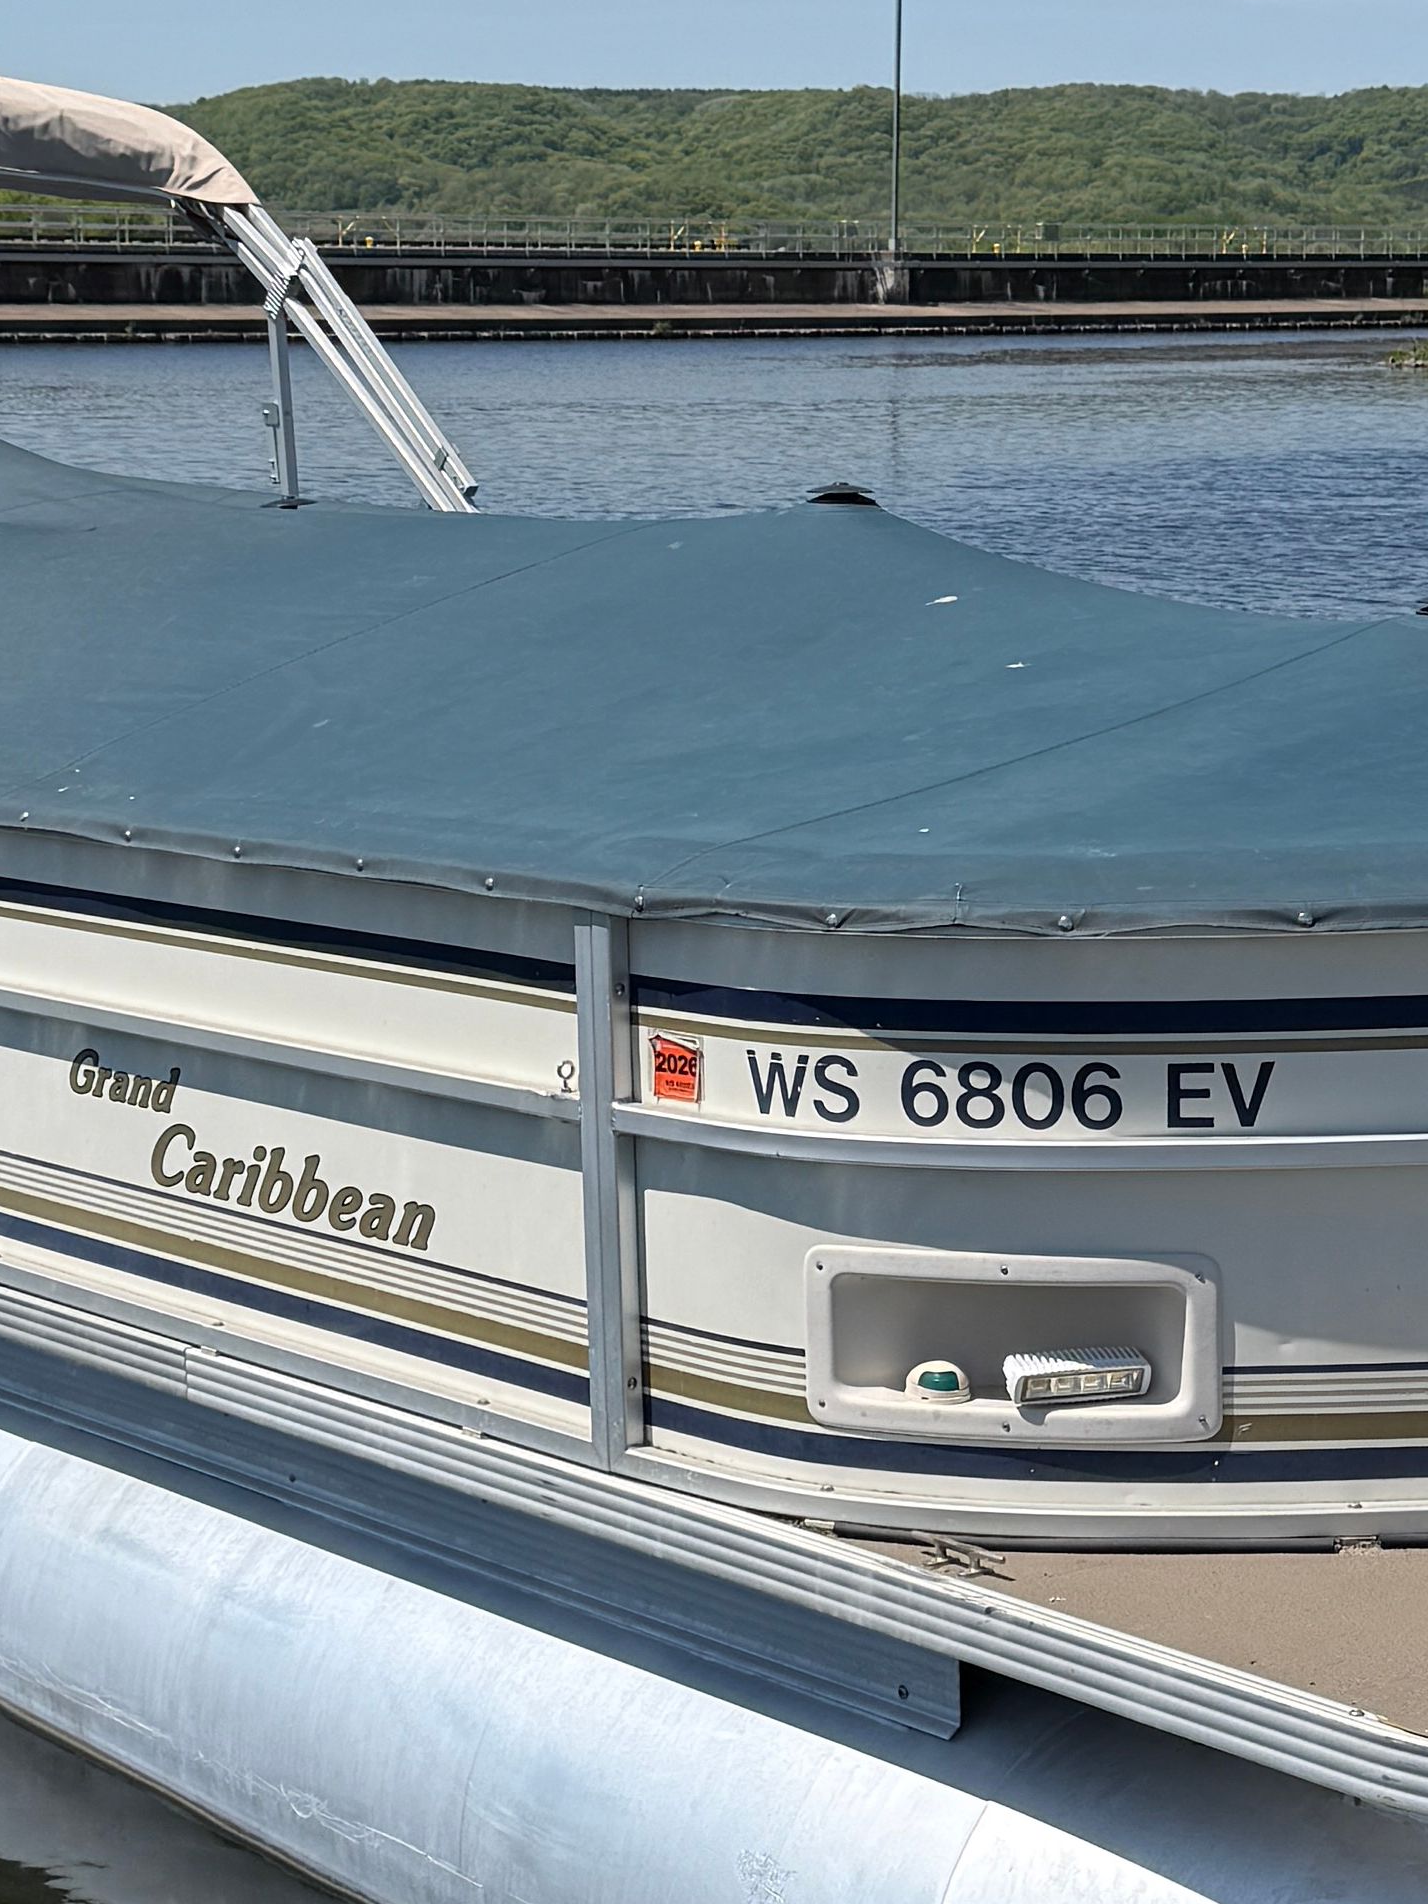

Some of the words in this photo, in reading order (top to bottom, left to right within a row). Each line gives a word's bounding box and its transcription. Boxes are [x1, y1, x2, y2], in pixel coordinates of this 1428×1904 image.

[69, 1047, 182, 1114] Grand
[745, 1049, 860, 1123] WS
[900, 1059, 1124, 1130] 6806
[1166, 1060, 1276, 1128] EV
[150, 1123, 436, 1251] Caribbean
